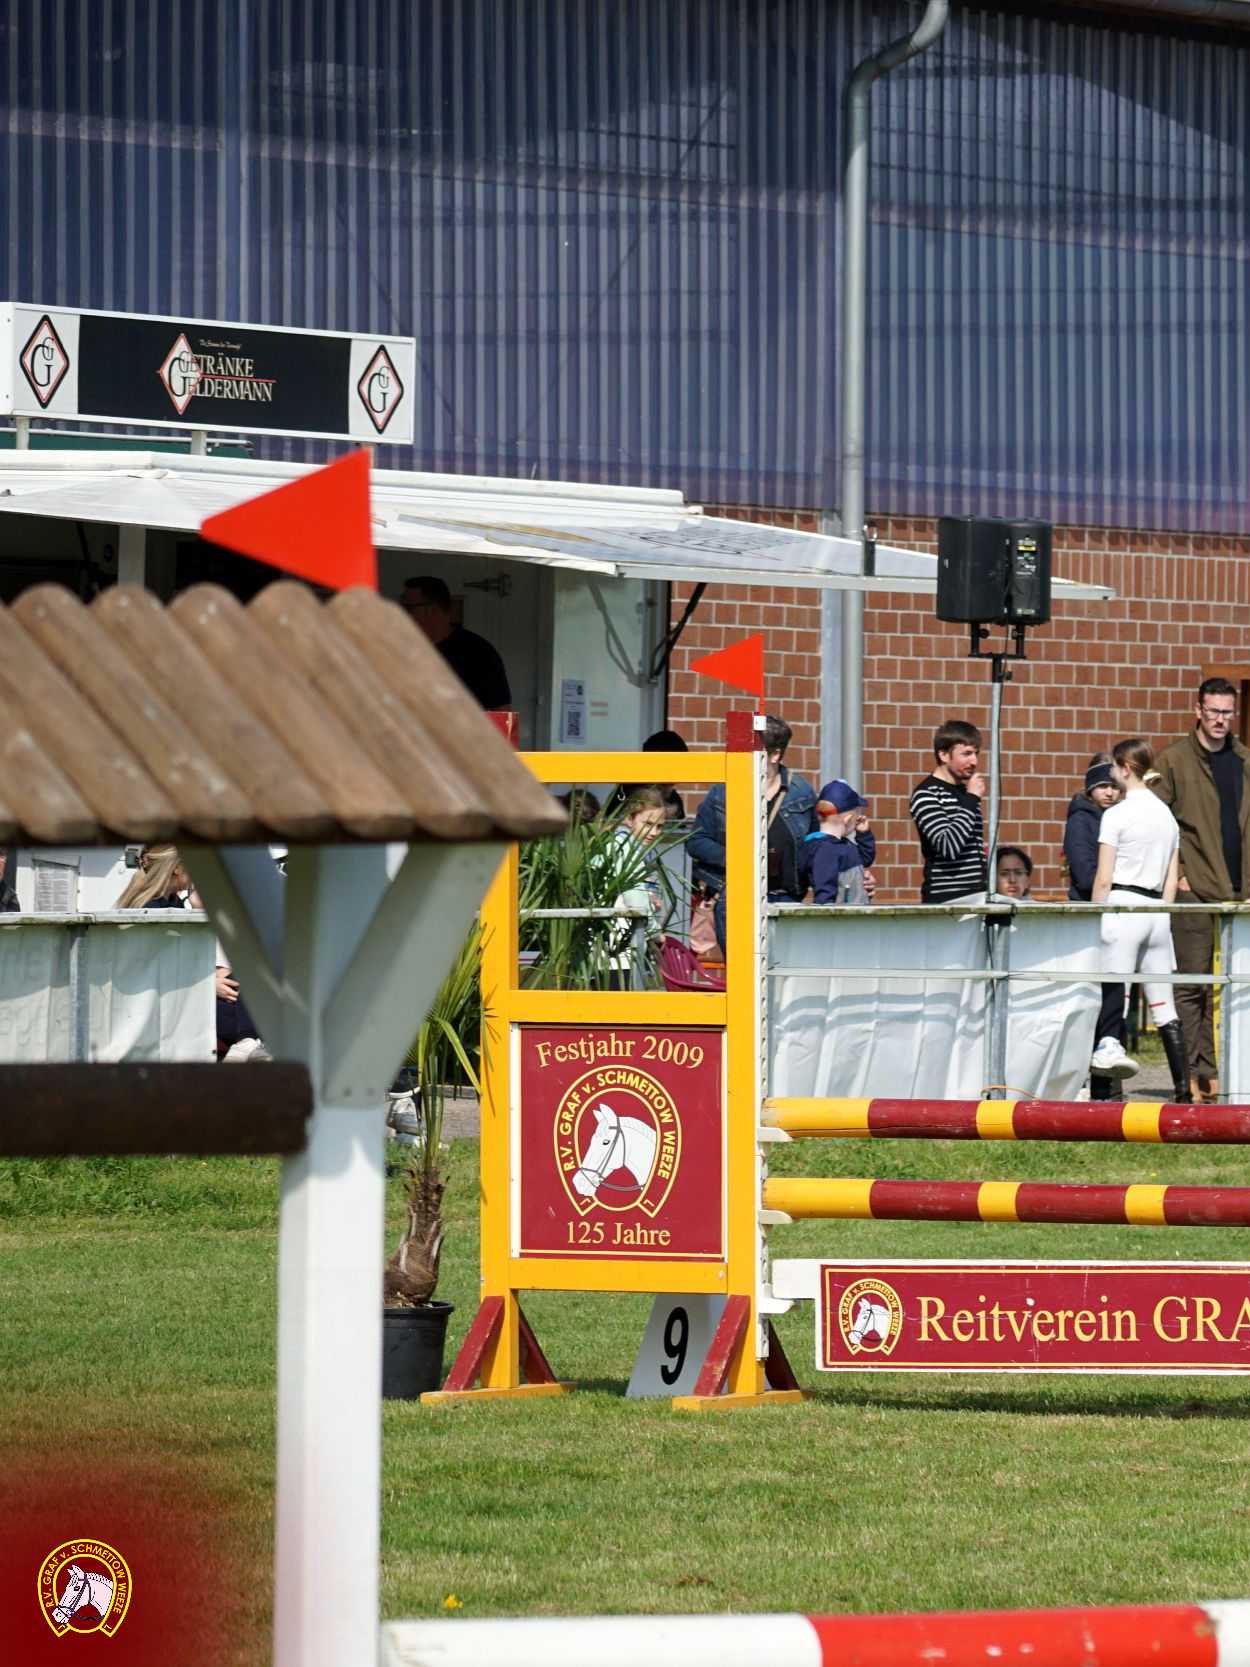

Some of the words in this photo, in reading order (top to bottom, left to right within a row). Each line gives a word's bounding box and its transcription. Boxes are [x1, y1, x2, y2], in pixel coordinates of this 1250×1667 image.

[536, 1033, 636, 1068] Festjahr
[642, 1035, 704, 1069] 2009
[560, 1091, 583, 1135] GRAF
[597, 1071, 674, 1123] SCHMETTOW
[658, 1131, 676, 1179] WEEZE
[567, 1221, 605, 1243] 125
[612, 1222, 671, 1245] Jahre
[916, 1295, 1139, 1343] Reitverein
[661, 1307, 688, 1385] 9
